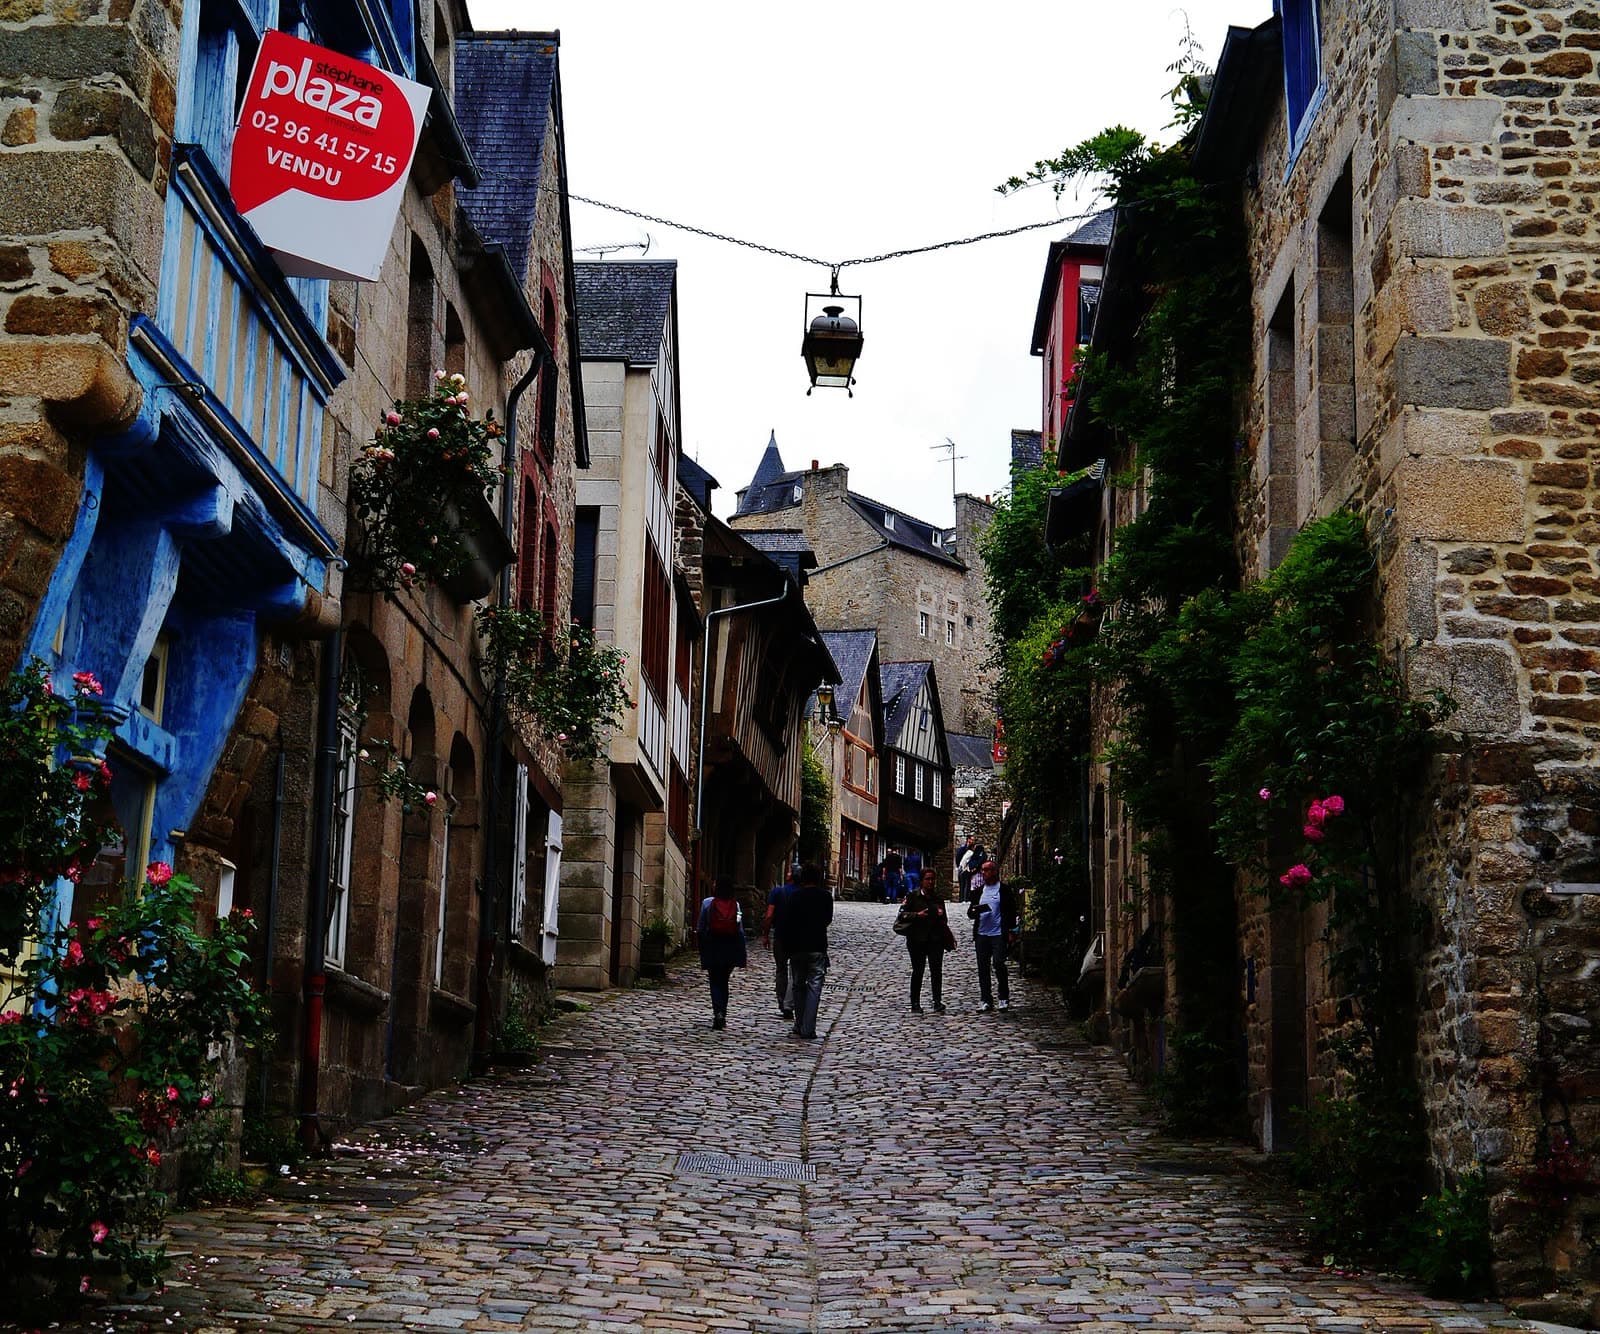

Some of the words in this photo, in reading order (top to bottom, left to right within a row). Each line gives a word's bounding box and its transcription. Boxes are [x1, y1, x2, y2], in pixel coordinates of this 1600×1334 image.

[260, 57, 383, 130] plaza
[252, 110, 280, 134] 02
[283, 120, 311, 144] 96
[313, 132, 338, 156] 41
[343, 142, 370, 165] 57
[371, 152, 397, 175] 15
[266, 146, 342, 186] VENDU
